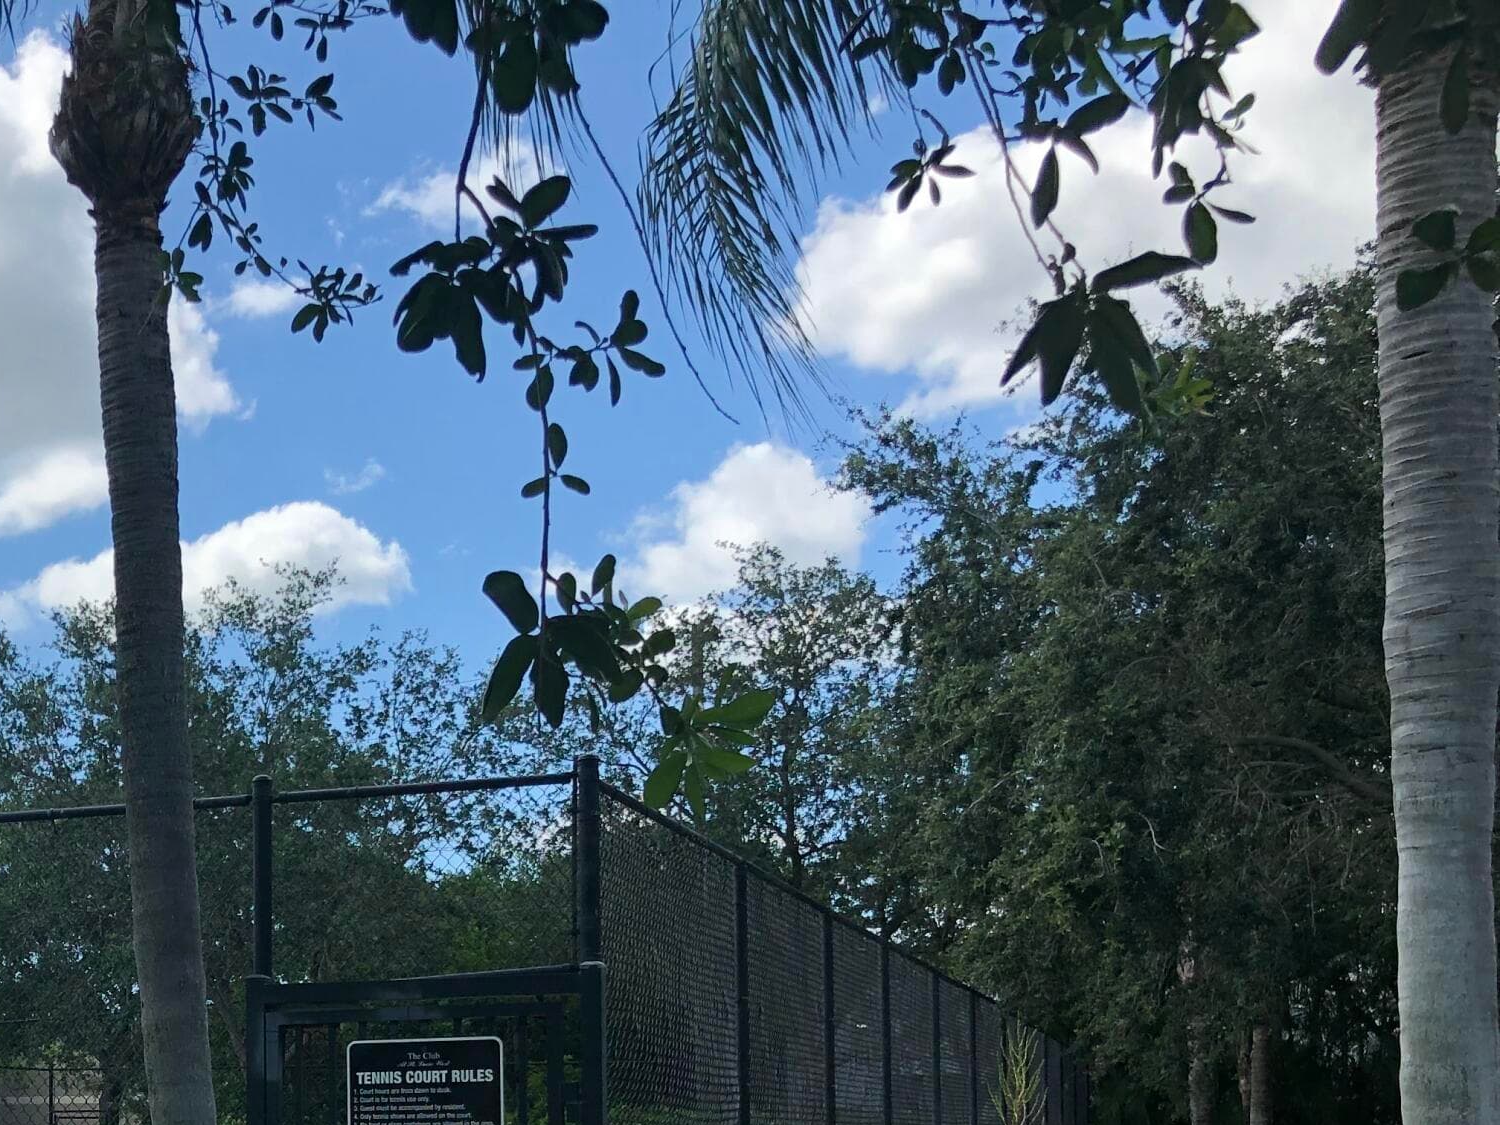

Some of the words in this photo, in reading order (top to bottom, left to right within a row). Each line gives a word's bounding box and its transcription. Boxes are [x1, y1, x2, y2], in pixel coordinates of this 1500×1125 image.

[356, 1071, 402, 1084] TENNIS
[406, 1070, 448, 1083] COURT
[451, 1069, 494, 1083] RULES
